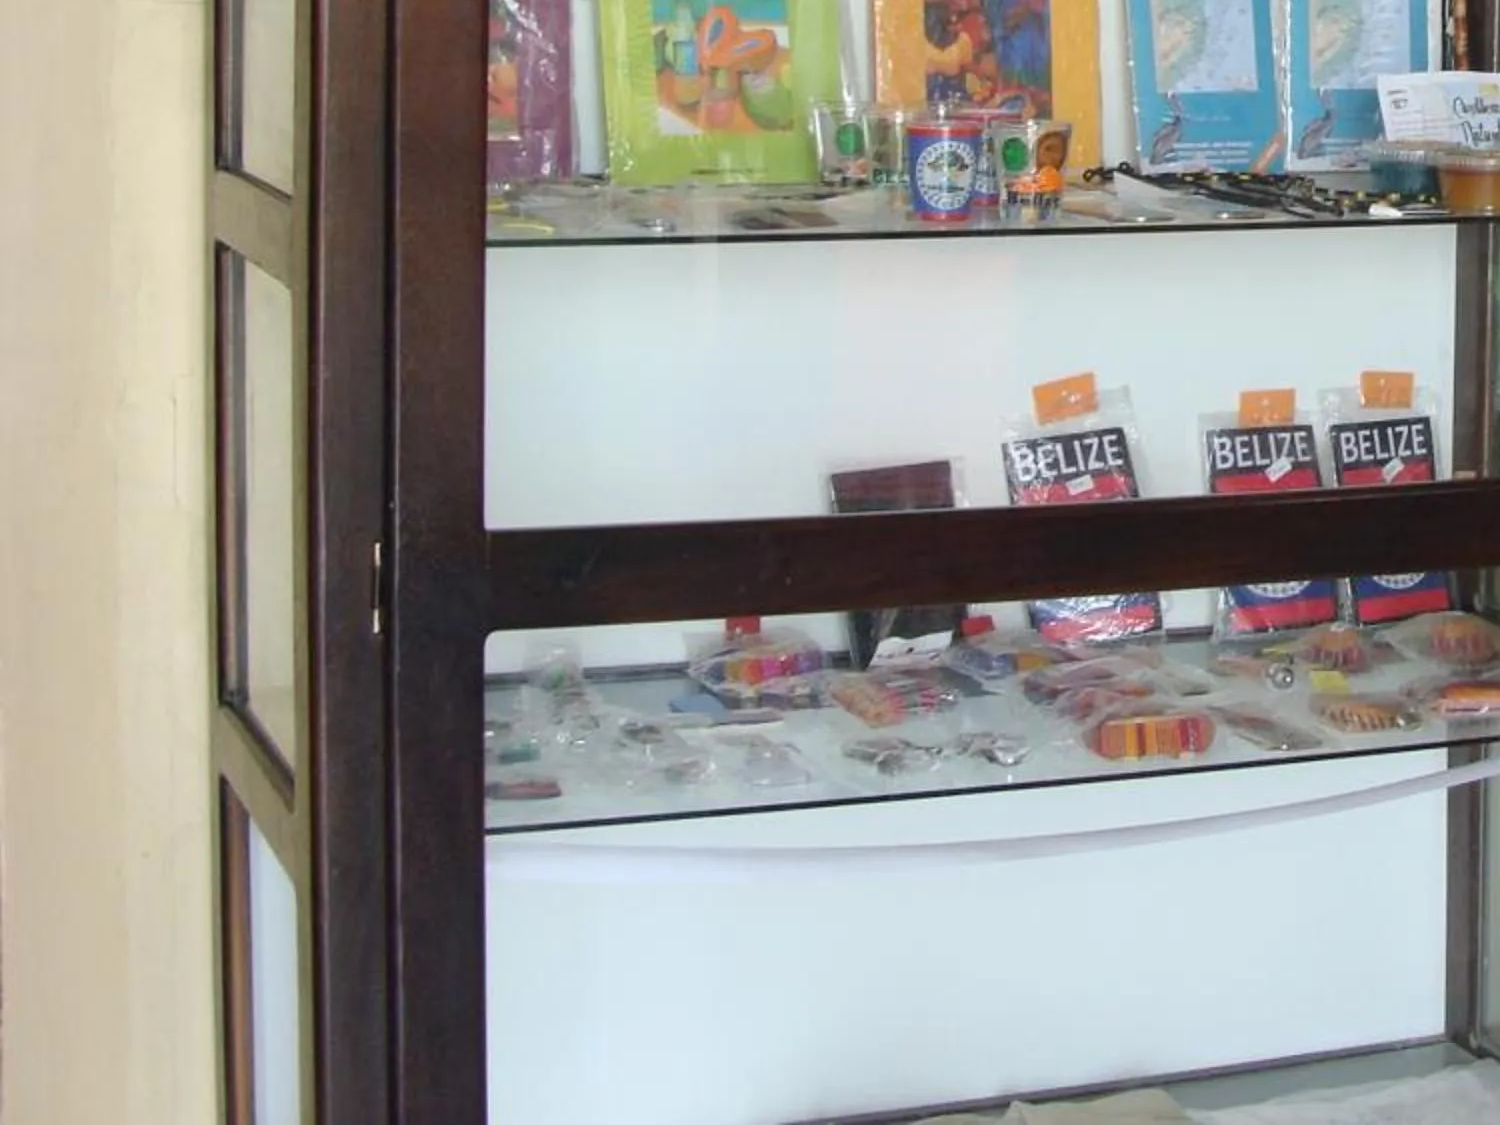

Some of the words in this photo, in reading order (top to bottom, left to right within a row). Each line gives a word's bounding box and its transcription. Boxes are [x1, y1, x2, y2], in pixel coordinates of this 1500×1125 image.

[1013, 433, 1124, 482] BELIZE
[1214, 430, 1313, 471] BELIZE
[1339, 422, 1428, 464] BELIZE
